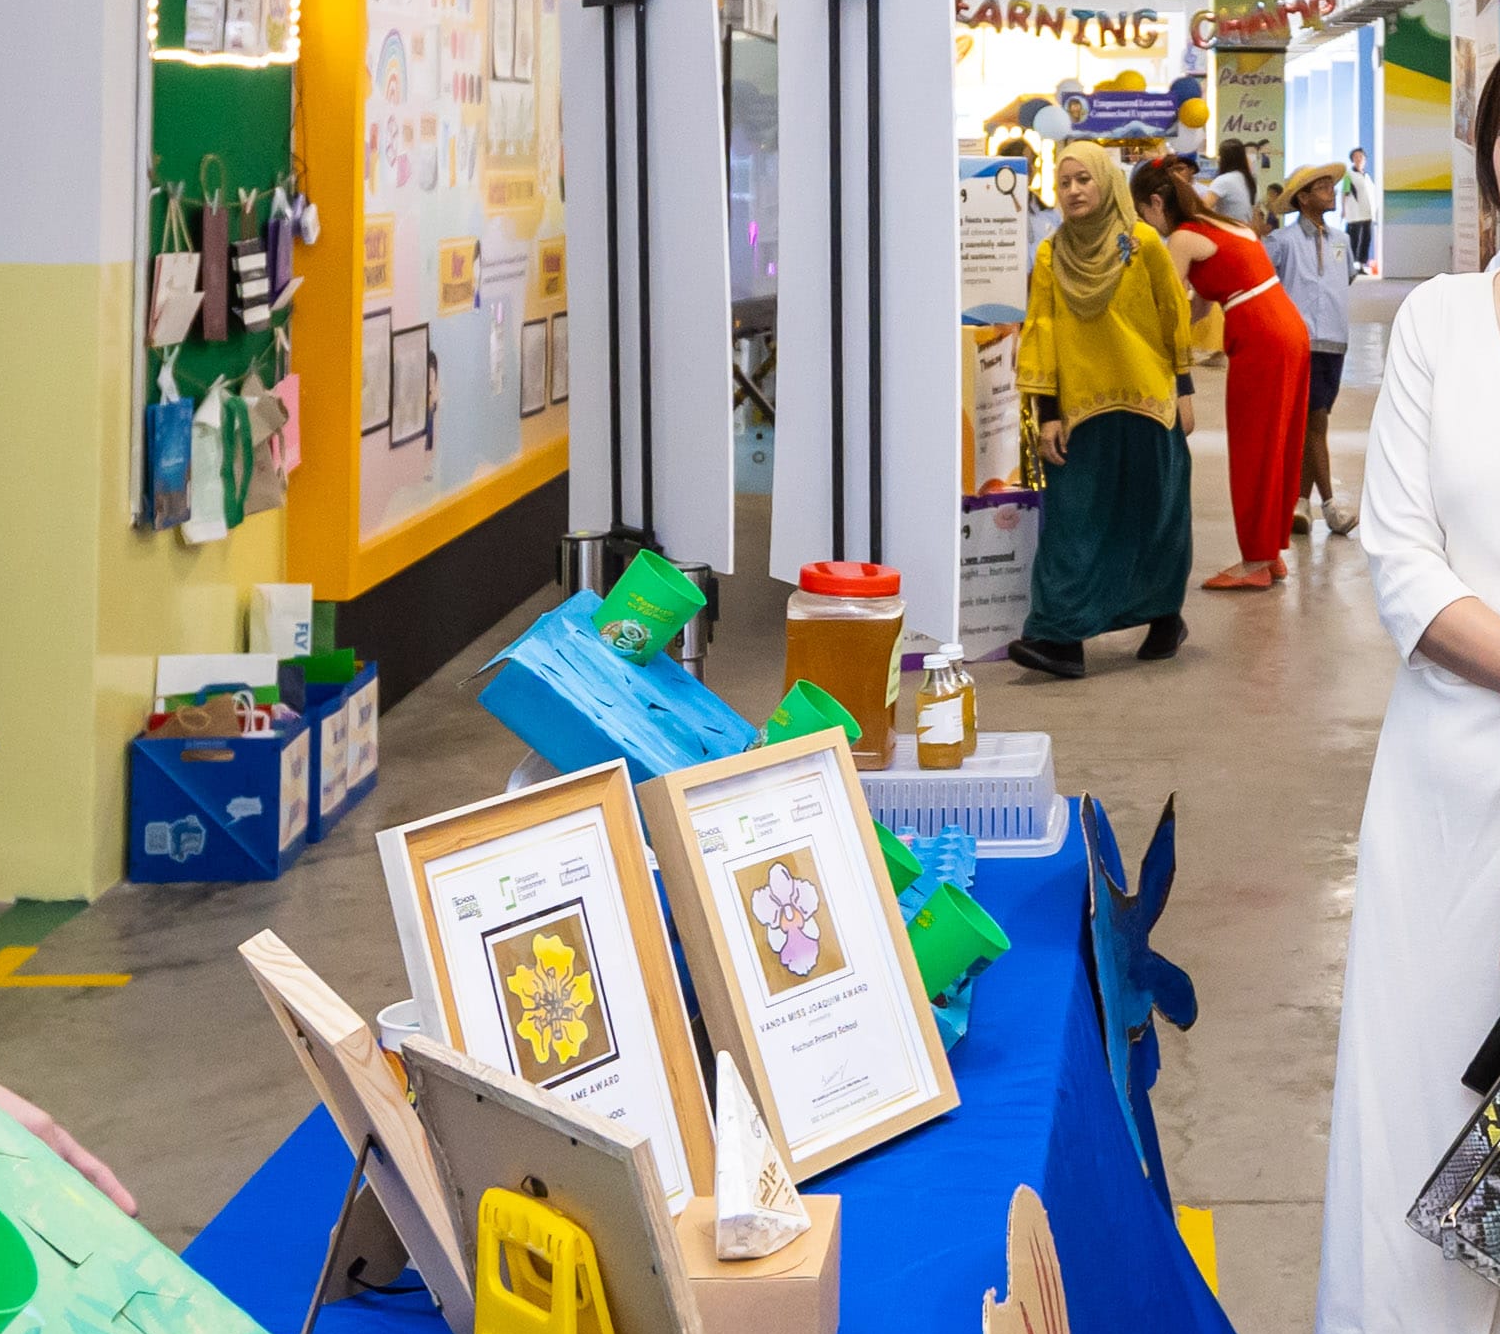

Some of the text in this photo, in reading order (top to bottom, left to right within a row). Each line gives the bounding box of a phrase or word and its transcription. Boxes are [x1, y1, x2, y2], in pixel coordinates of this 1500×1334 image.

[1218, 67, 1284, 87] Passion
[1223, 114, 1278, 133] Music
[295, 622, 309, 651] FLY
[759, 1017, 786, 1033] VANDA
[787, 1007, 807, 1022] MISS
[808, 995, 840, 1015] JOAQUIM
[842, 983, 869, 1000] AWARD
[791, 1020, 859, 1054] Fuchun Primary School
[571, 1074, 620, 1102] AME AWARD
